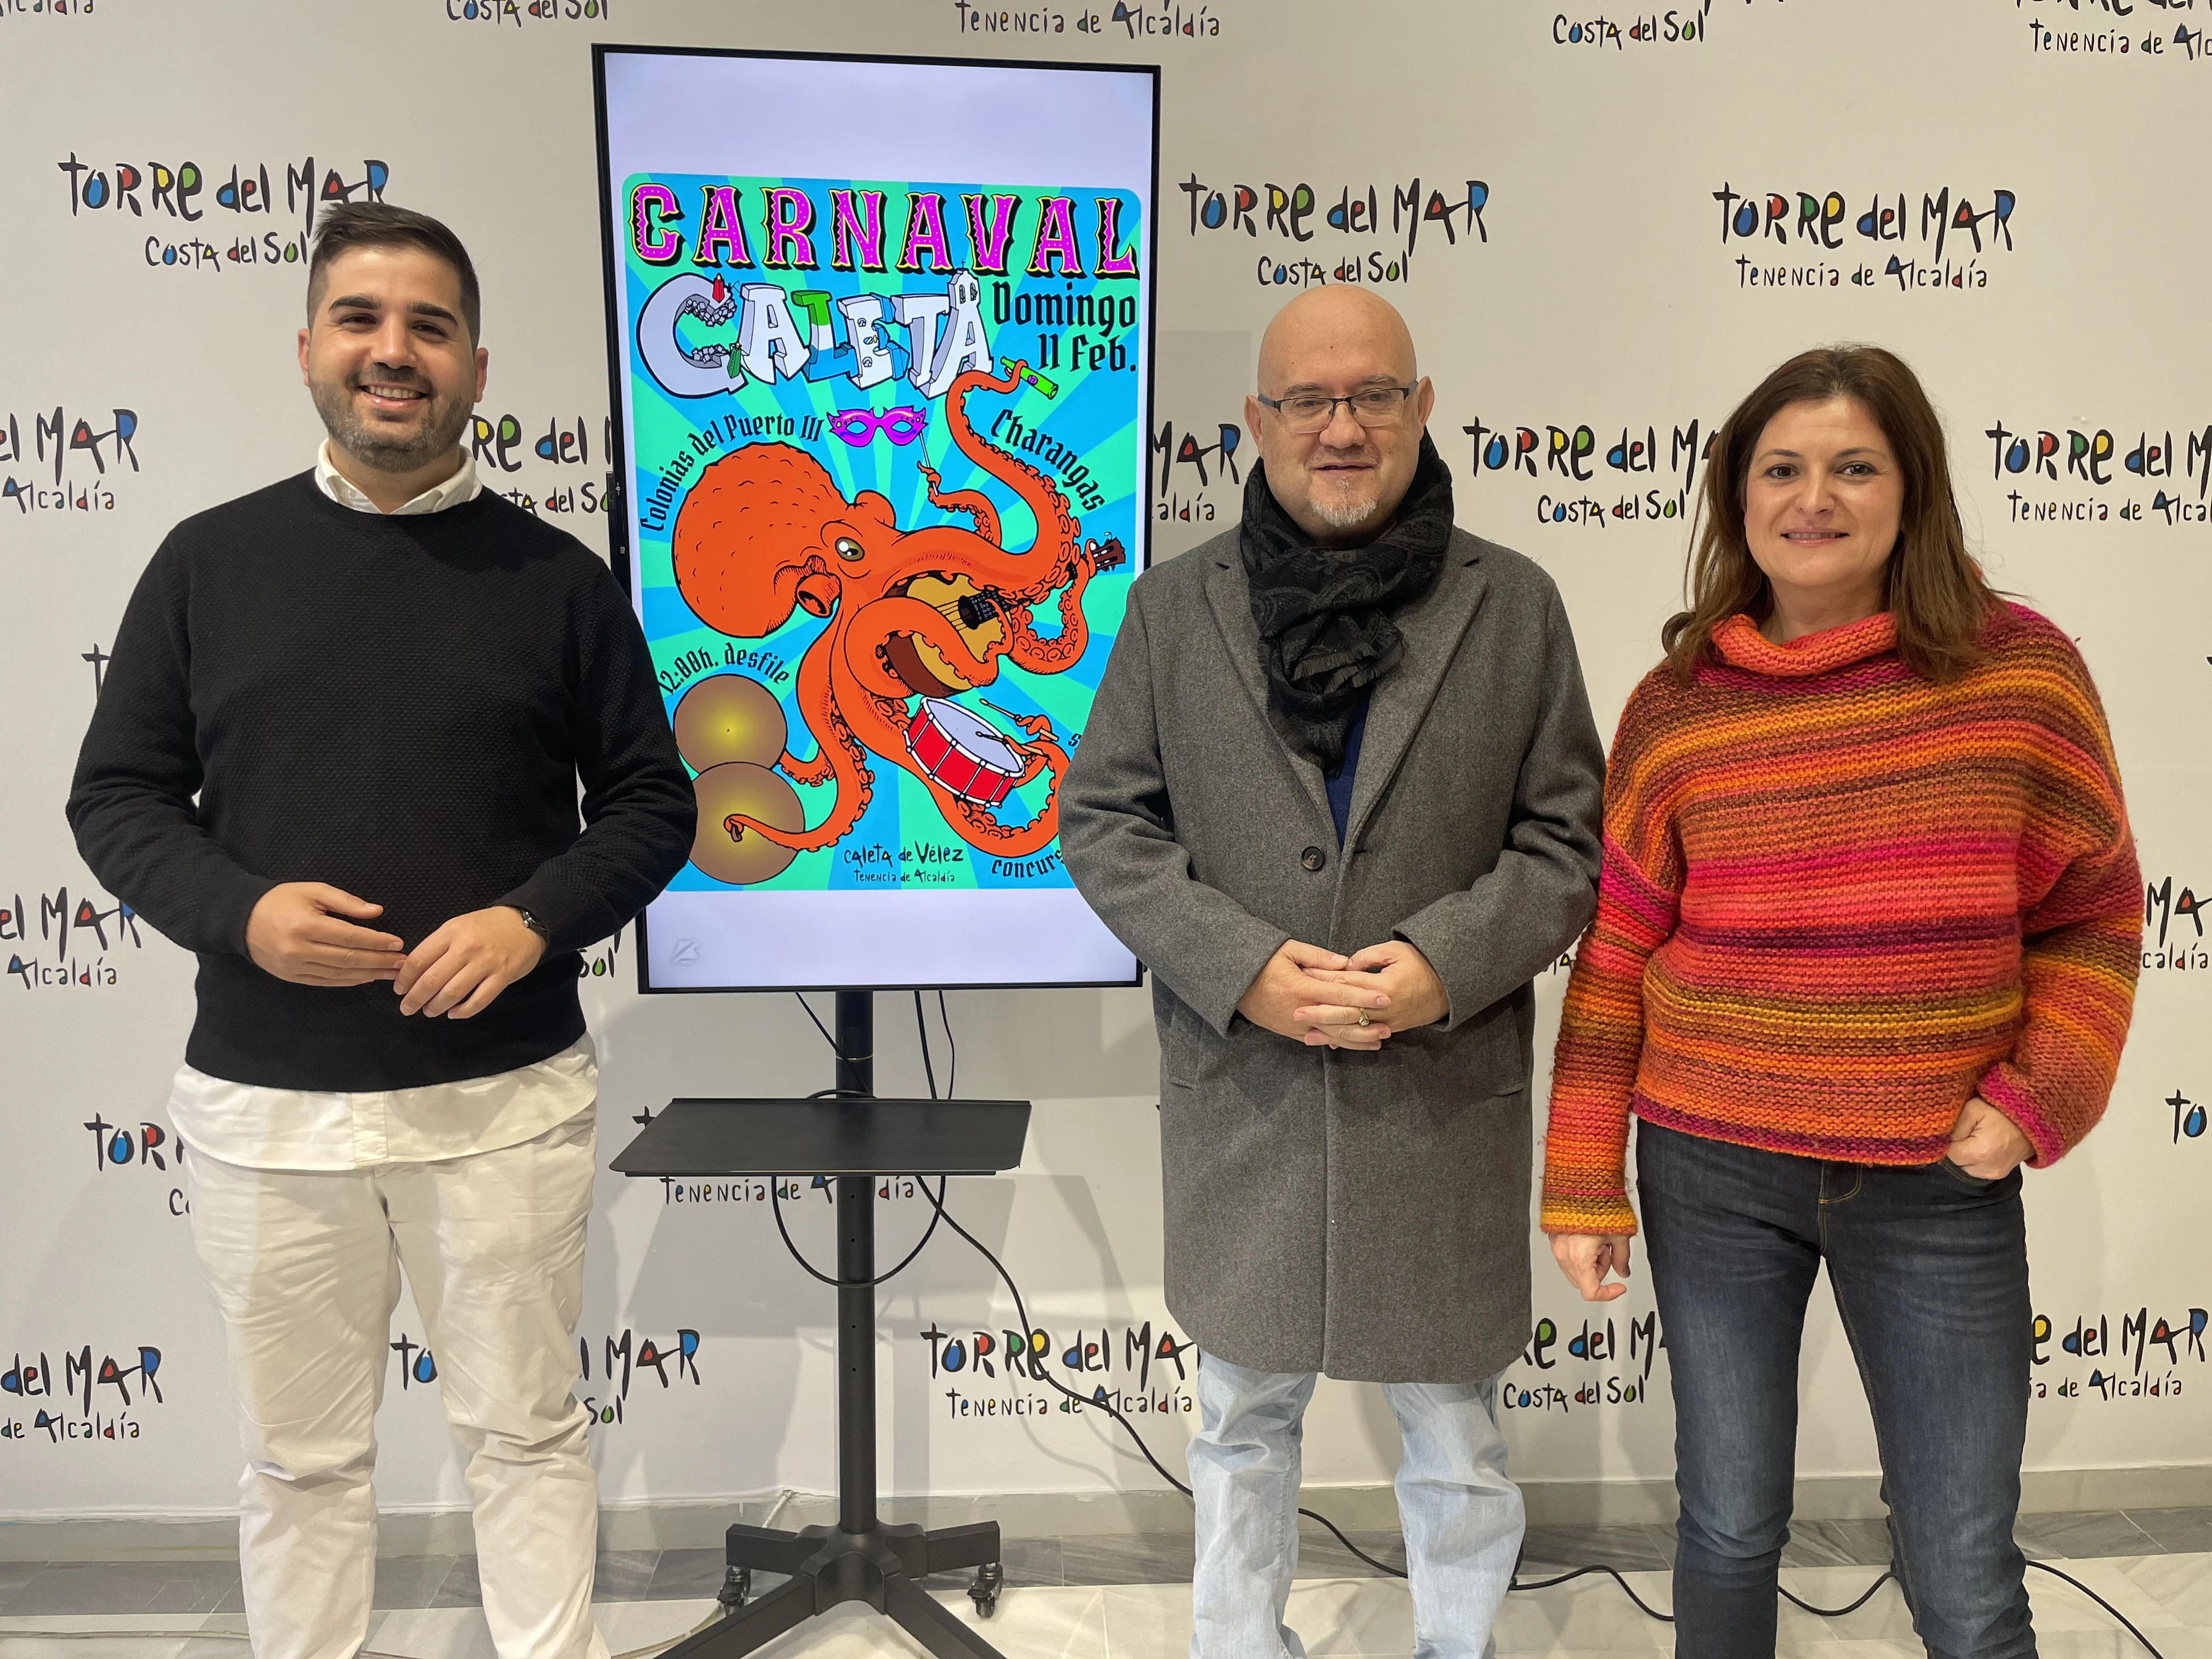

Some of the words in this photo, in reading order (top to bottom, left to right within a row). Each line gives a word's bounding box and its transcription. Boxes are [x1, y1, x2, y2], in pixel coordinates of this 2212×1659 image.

[528, 0, 557, 19] del
[1076, 9, 1102, 34] de
[1111, 0, 1220, 40] Alcaldía
[1629, 15, 1656, 42] del
[1664, 10, 1703, 42] Sol
[2141, 31, 2163, 55] de
[216, 162, 270, 213] del
[287, 156, 389, 238] MAR
[629, 183, 1141, 281] CARNAVAL
[1327, 184, 1377, 234] del
[1393, 178, 1489, 257] MAR
[1856, 193, 1906, 241] del
[1922, 187, 2016, 264] MAR
[227, 236, 257, 264] del
[263, 231, 307, 266] Sol
[1334, 255, 1361, 283] del
[1368, 250, 1408, 284] Sol
[1851, 263, 1875, 287] de
[1884, 253, 1988, 291] Alcaldía
[636, 258, 995, 400] CALETA
[992, 280, 1136, 338] Domingo
[1037, 333, 1060, 370] 11
[1070, 334, 1136, 373] Feb.
[37, 406, 139, 487] MAR
[535, 416, 587, 465] del
[991, 409, 1105, 511] Charangas
[1606, 426, 1655, 472] del
[2124, 431, 2172, 477] del
[640, 450, 695, 531] Colonias
[687, 420, 725, 456] del
[723, 413, 794, 442] Puerto
[799, 415, 825, 442] III
[2, 476, 115, 514] Alcaldía
[545, 486, 574, 514] del
[1153, 492, 1215, 522] aldía
[1612, 494, 1639, 520] del
[1646, 488, 1684, 520] Sol
[2119, 498, 2142, 521] de
[724, 642, 789, 684] desfile
[898, 847, 913, 862] de
[915, 840, 964, 864] Vélez
[900, 872, 911, 883] de
[0, 893, 25, 941] el
[2146, 876, 2212, 948] MA
[7, 953, 117, 990] Alcaldía
[2142, 942, 2208, 970] caldía
[778, 1178, 802, 1200] de
[1062, 1328, 1110, 1372] del
[1126, 1321, 1201, 1392] MA
[1568, 1318, 1615, 1361] del
[2062, 1314, 2108, 1357] del
[2122, 1307, 2209, 1376] MAR
[1, 1352, 50, 1397] del
[66, 1345, 163, 1418] MAR
[606, 1329, 700, 1401] MAR
[2058, 1377, 2079, 1398] de
[2088, 1368, 2182, 1401] Alcaldía
[1059, 1395, 1083, 1414] de
[1575, 1380, 1600, 1404] del
[1607, 1374, 1644, 1404] Sol
[1, 1418, 25, 1440] de
[34, 1408, 140, 1443] Alcaldía
